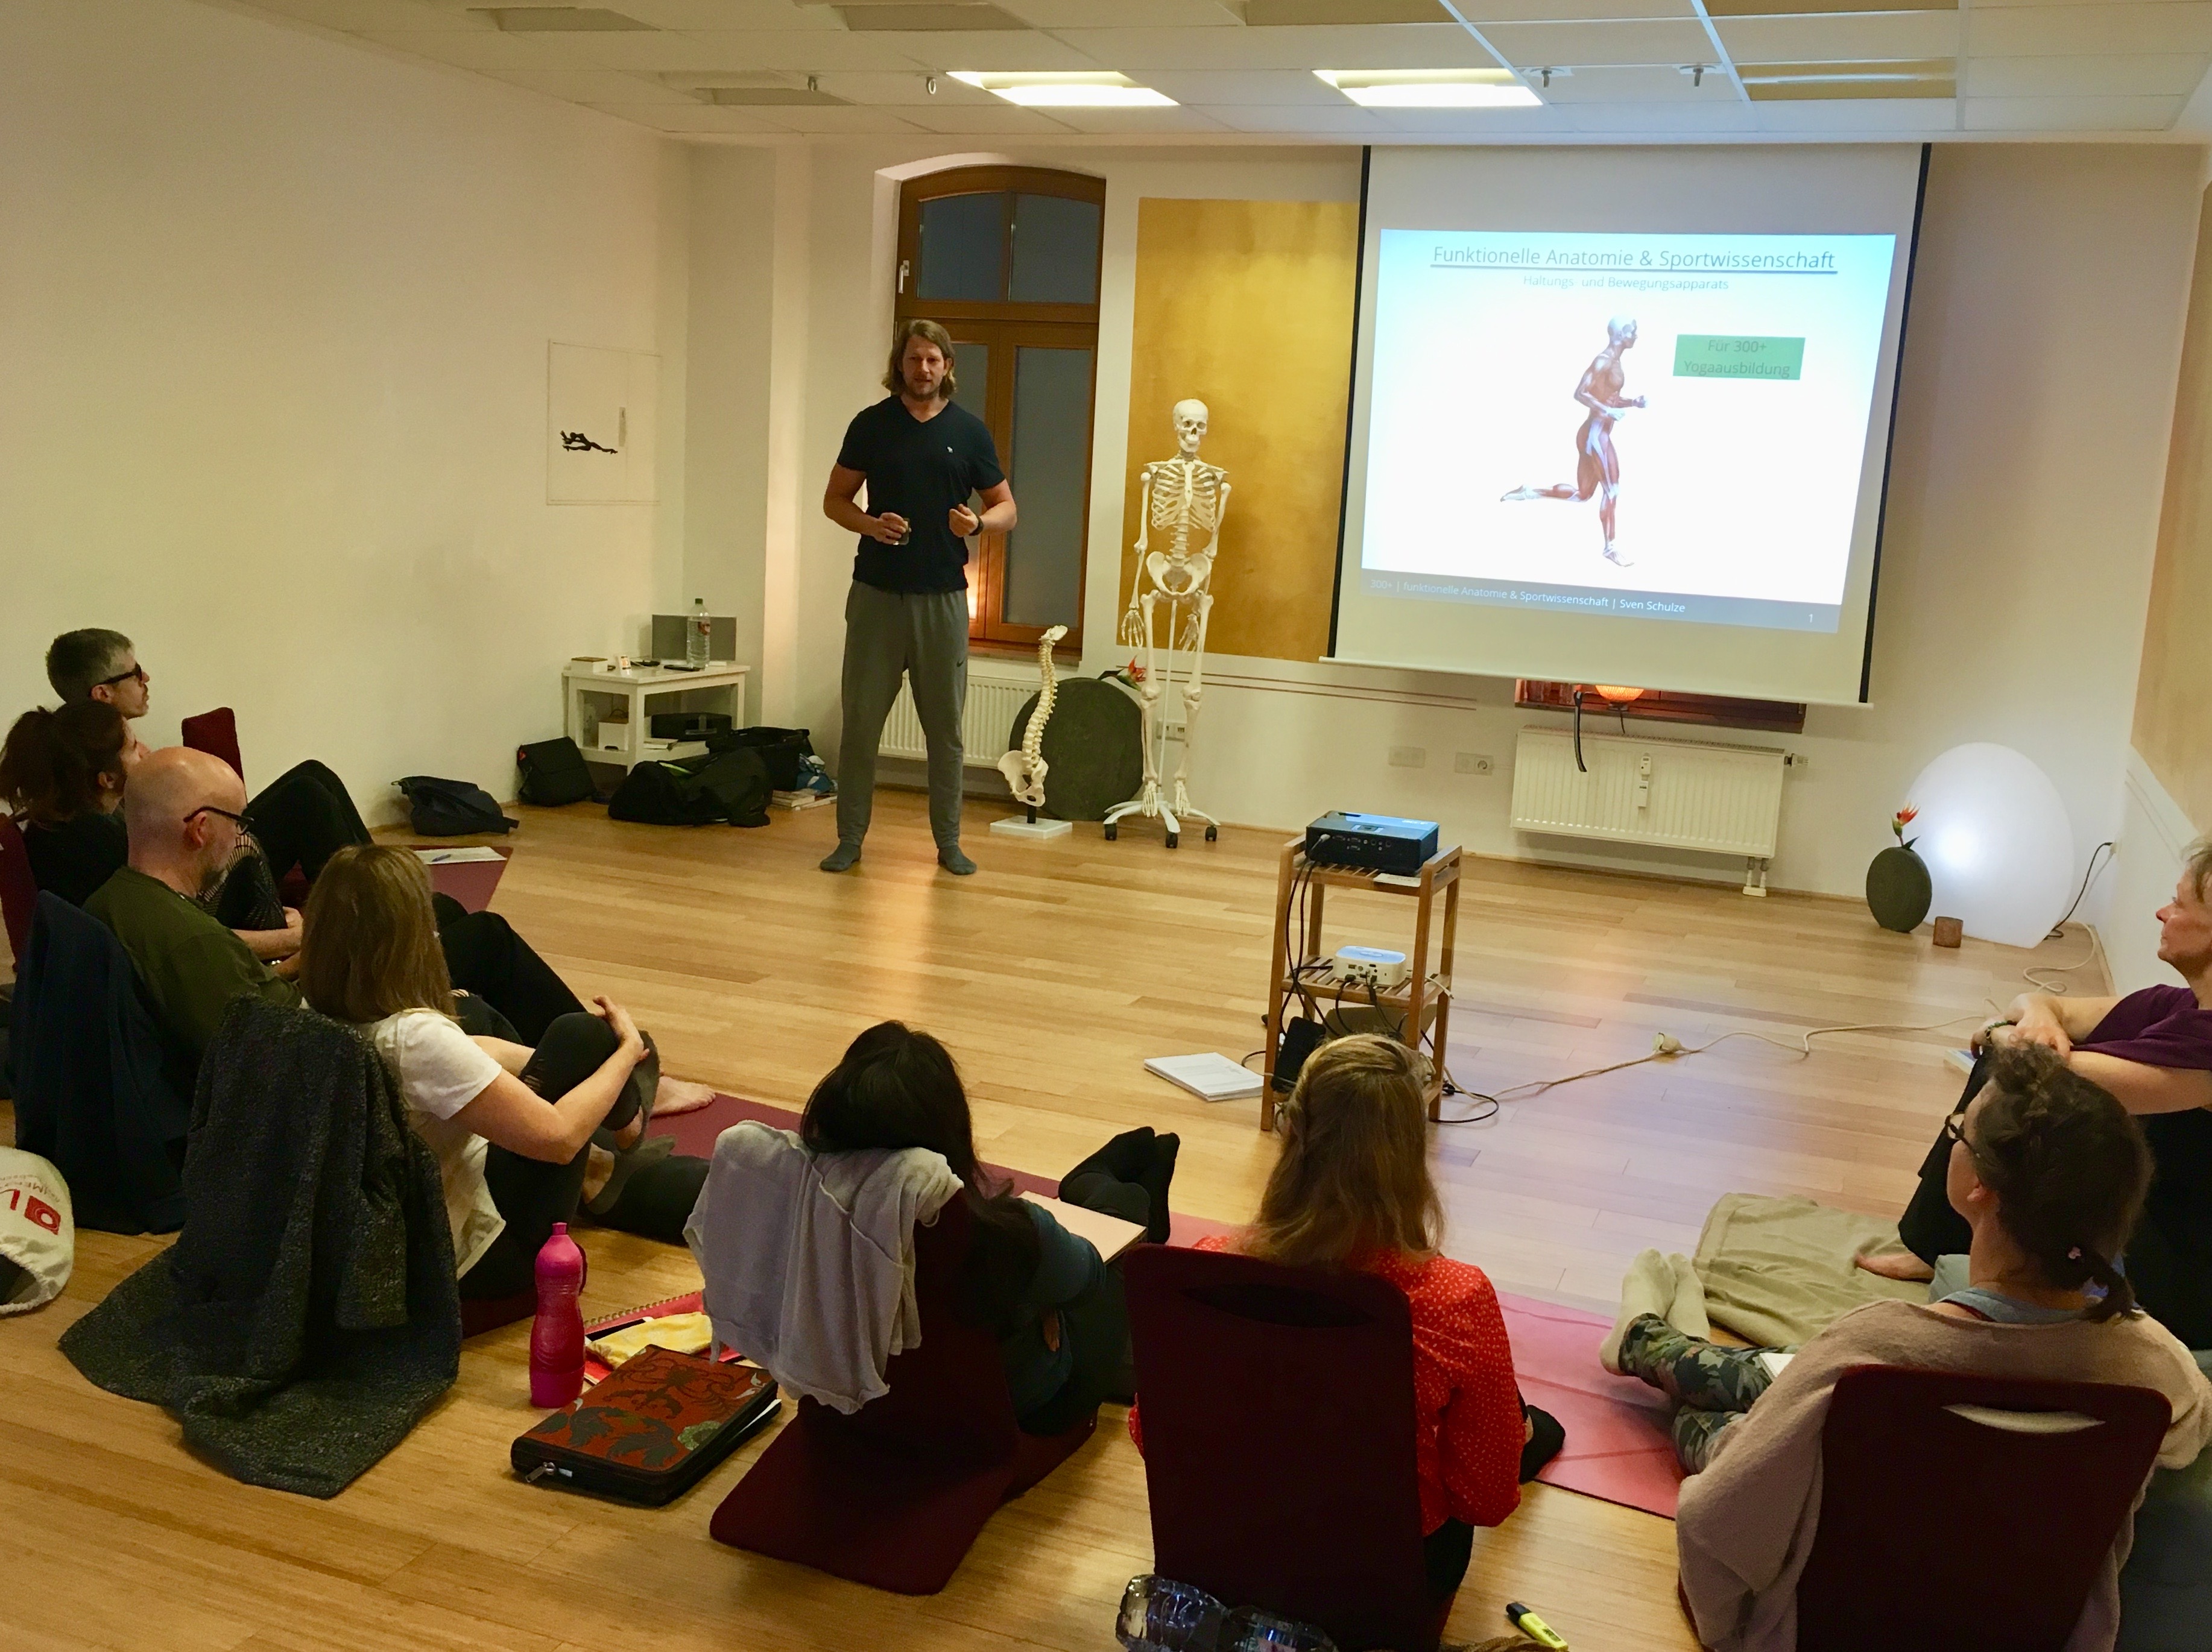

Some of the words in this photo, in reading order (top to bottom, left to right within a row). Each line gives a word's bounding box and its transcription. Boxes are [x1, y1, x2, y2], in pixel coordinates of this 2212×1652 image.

[1433, 246, 1541, 264] Funktionelle
[1545, 249, 1634, 266] Anatomie
[1639, 250, 1654, 266] &
[1659, 250, 1835, 270] Sportwissenschaft
[1581, 276, 1604, 288] und
[1608, 277, 1729, 291] Bewegungsapparats
[1707, 339, 1730, 352] Für
[1733, 340, 1768, 353] 300+
[1683, 361, 1790, 379] Yogaausbildung
[1370, 579, 1392, 589] 300+
[1403, 581, 1459, 595] funktionelle
[1461, 586, 1508, 599] Anatomie
[1509, 590, 1518, 599] &
[1520, 591, 1609, 607] Sportwissenschaft
[1620, 599, 1644, 610] Sven
[1646, 601, 1686, 613] Schulze
[1809, 613, 1813, 623] 1
